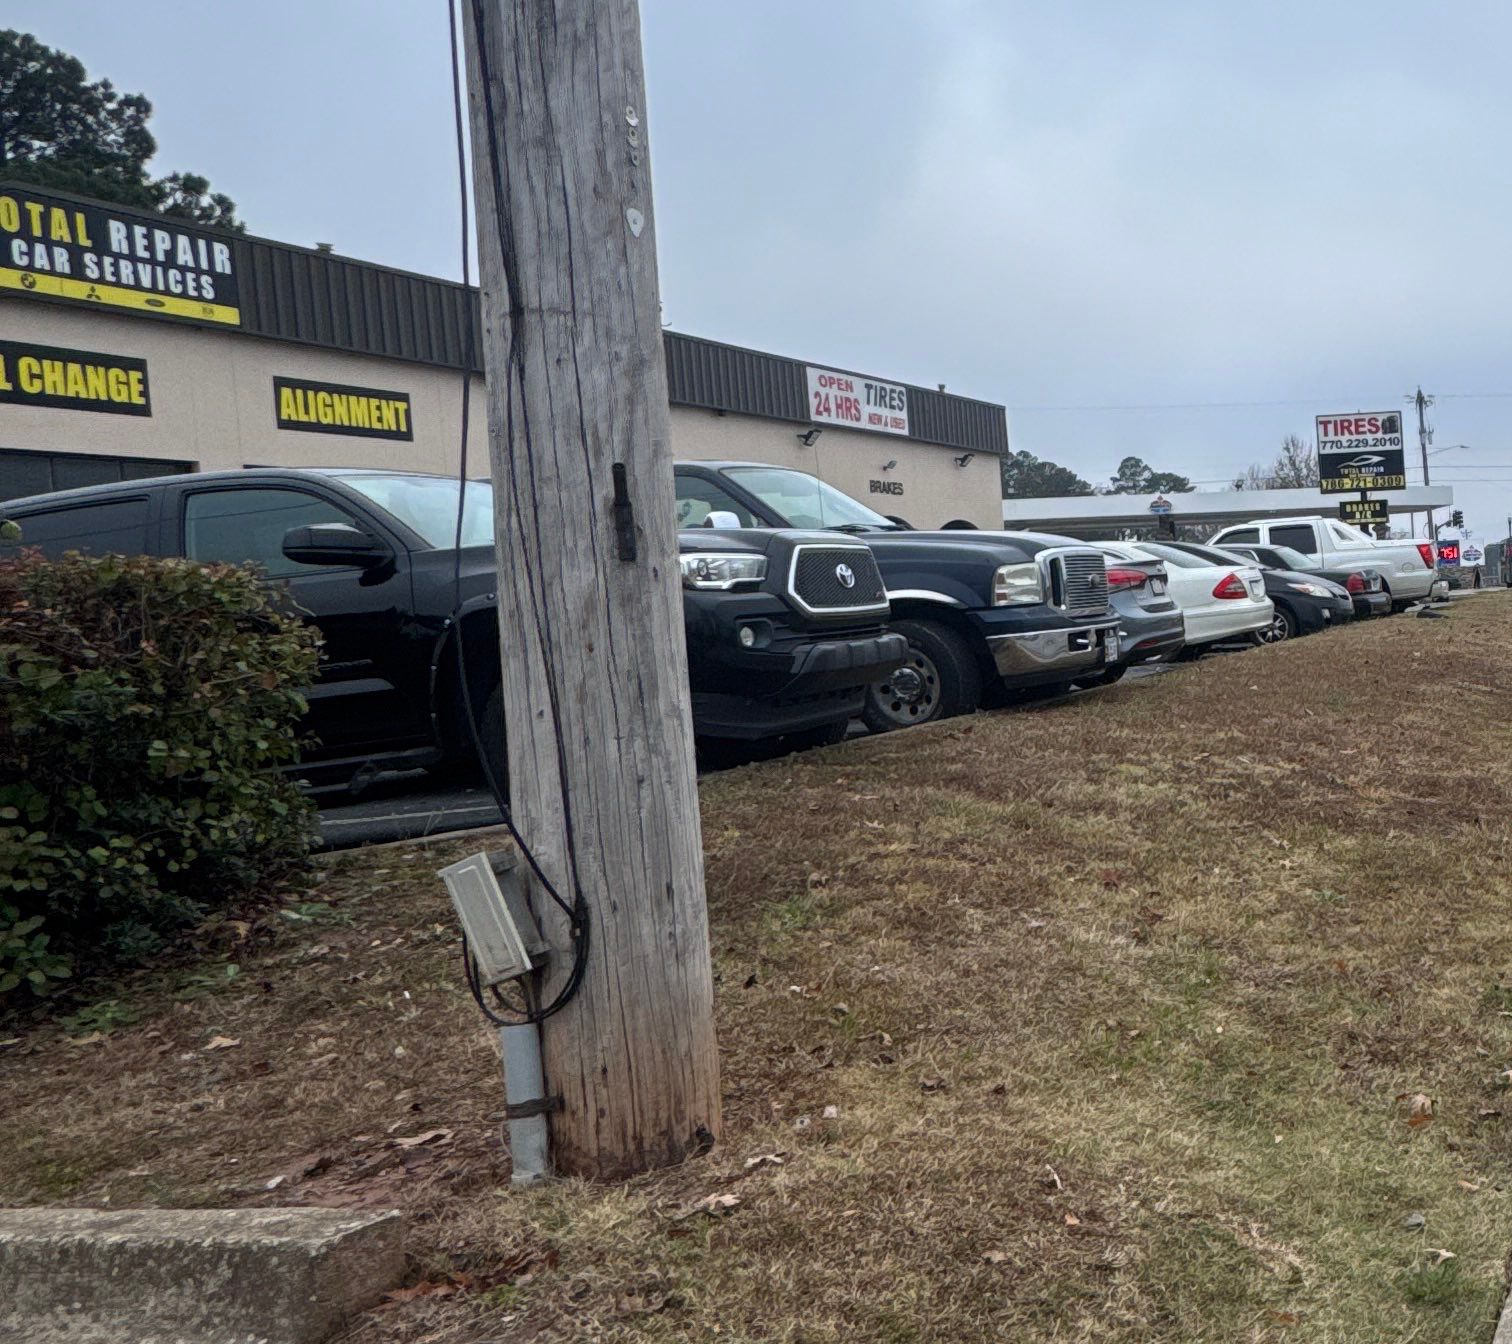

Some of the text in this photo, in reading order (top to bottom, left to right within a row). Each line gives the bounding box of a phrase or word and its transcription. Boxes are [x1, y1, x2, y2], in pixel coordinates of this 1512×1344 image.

[0, 195, 233, 275] OTAL REPAIR
[11, 238, 216, 300] CAR SERVICES
[18, 356, 146, 405] CHANGE
[818, 374, 854, 393] OPEN
[281, 386, 408, 432] ALIGNMENT
[814, 390, 861, 422] 24 HRS
[864, 383, 905, 412] TIRES
[1319, 417, 1381, 437] TIRES
[1321, 436, 1400, 450] 770.229.2010
[869, 479, 904, 496] BRAKES
